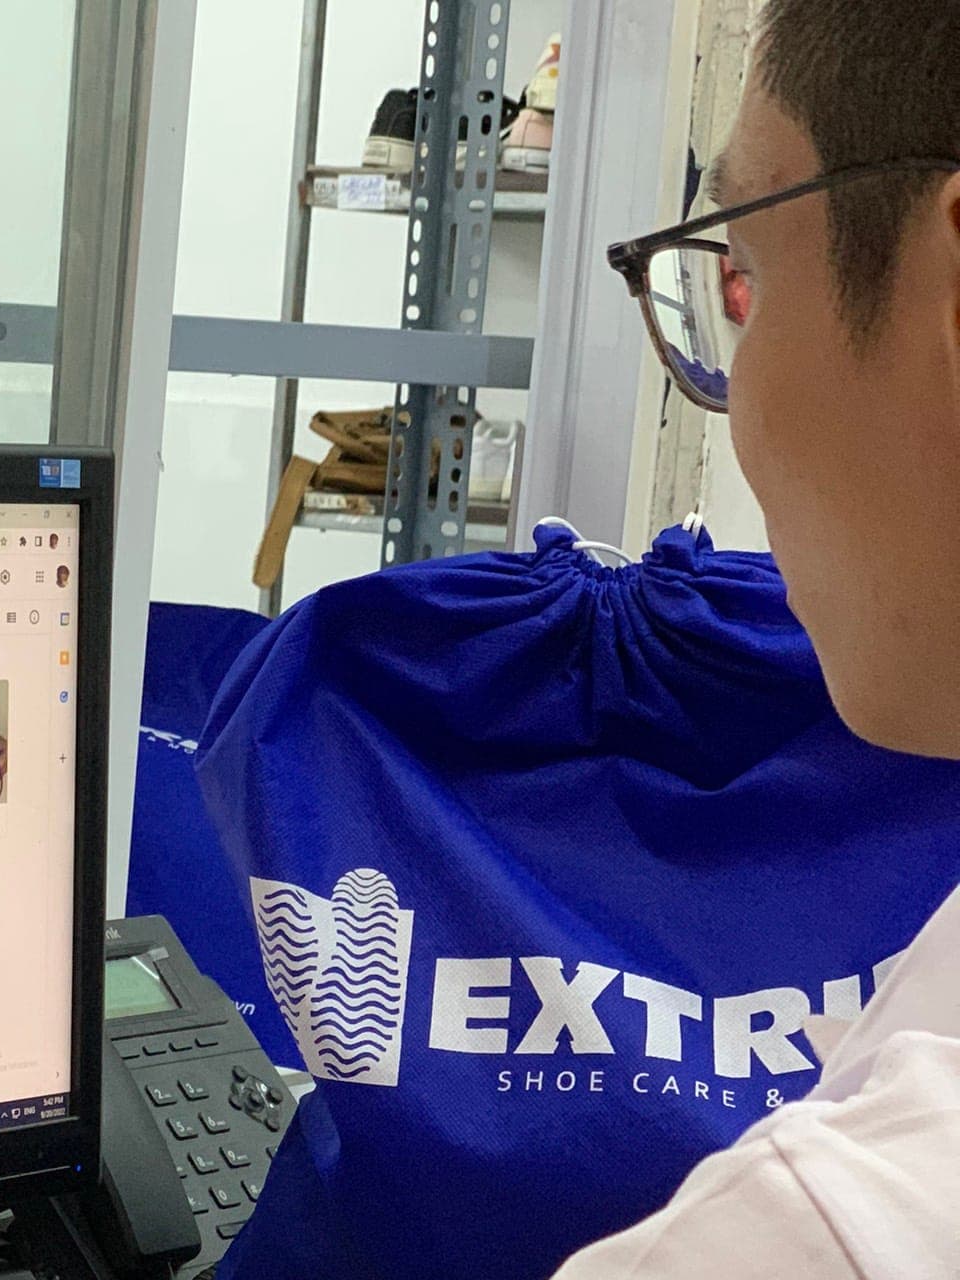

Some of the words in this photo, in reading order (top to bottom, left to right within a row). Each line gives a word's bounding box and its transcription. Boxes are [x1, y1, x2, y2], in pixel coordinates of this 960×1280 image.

[429, 949, 907, 1079] EXTR
[497, 1070, 605, 1093] SHOE
[632, 1072, 736, 1108] CARE
[765, 1089, 784, 1108] &
